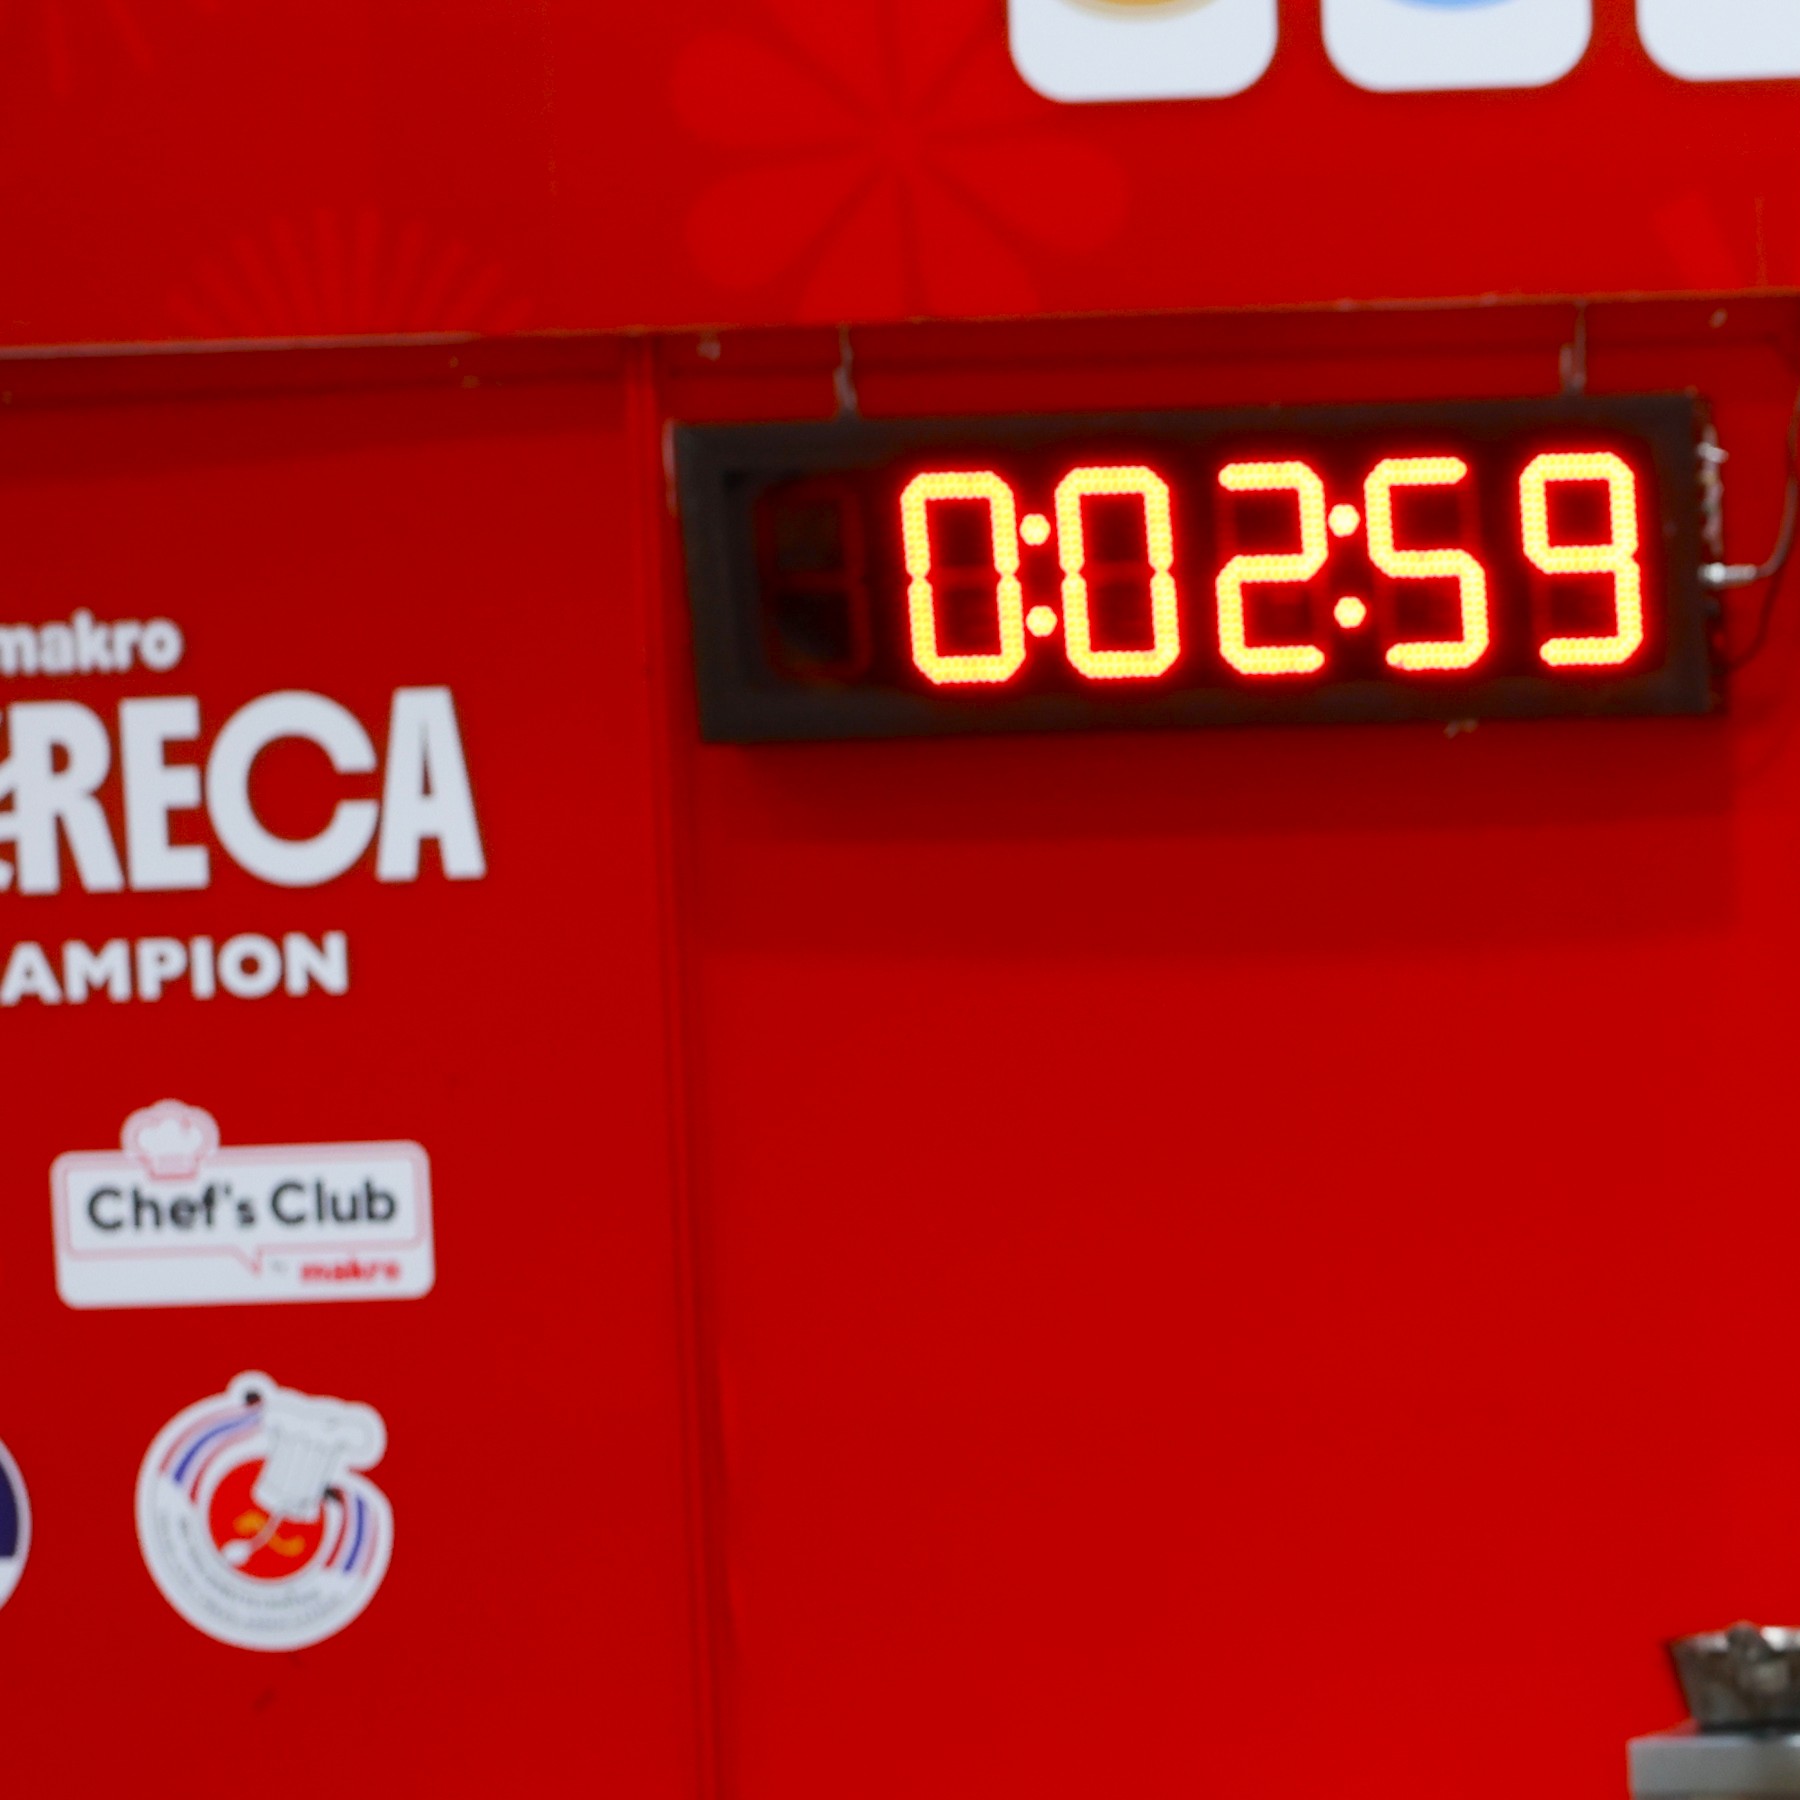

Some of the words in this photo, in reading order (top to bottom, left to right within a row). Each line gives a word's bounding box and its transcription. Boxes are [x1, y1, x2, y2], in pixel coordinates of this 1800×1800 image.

[3, 686, 487, 895] RECA
[0, 930, 348, 1006] AMPION
[87, 1181, 256, 1232] Chef's
[269, 1178, 397, 1226] Club
